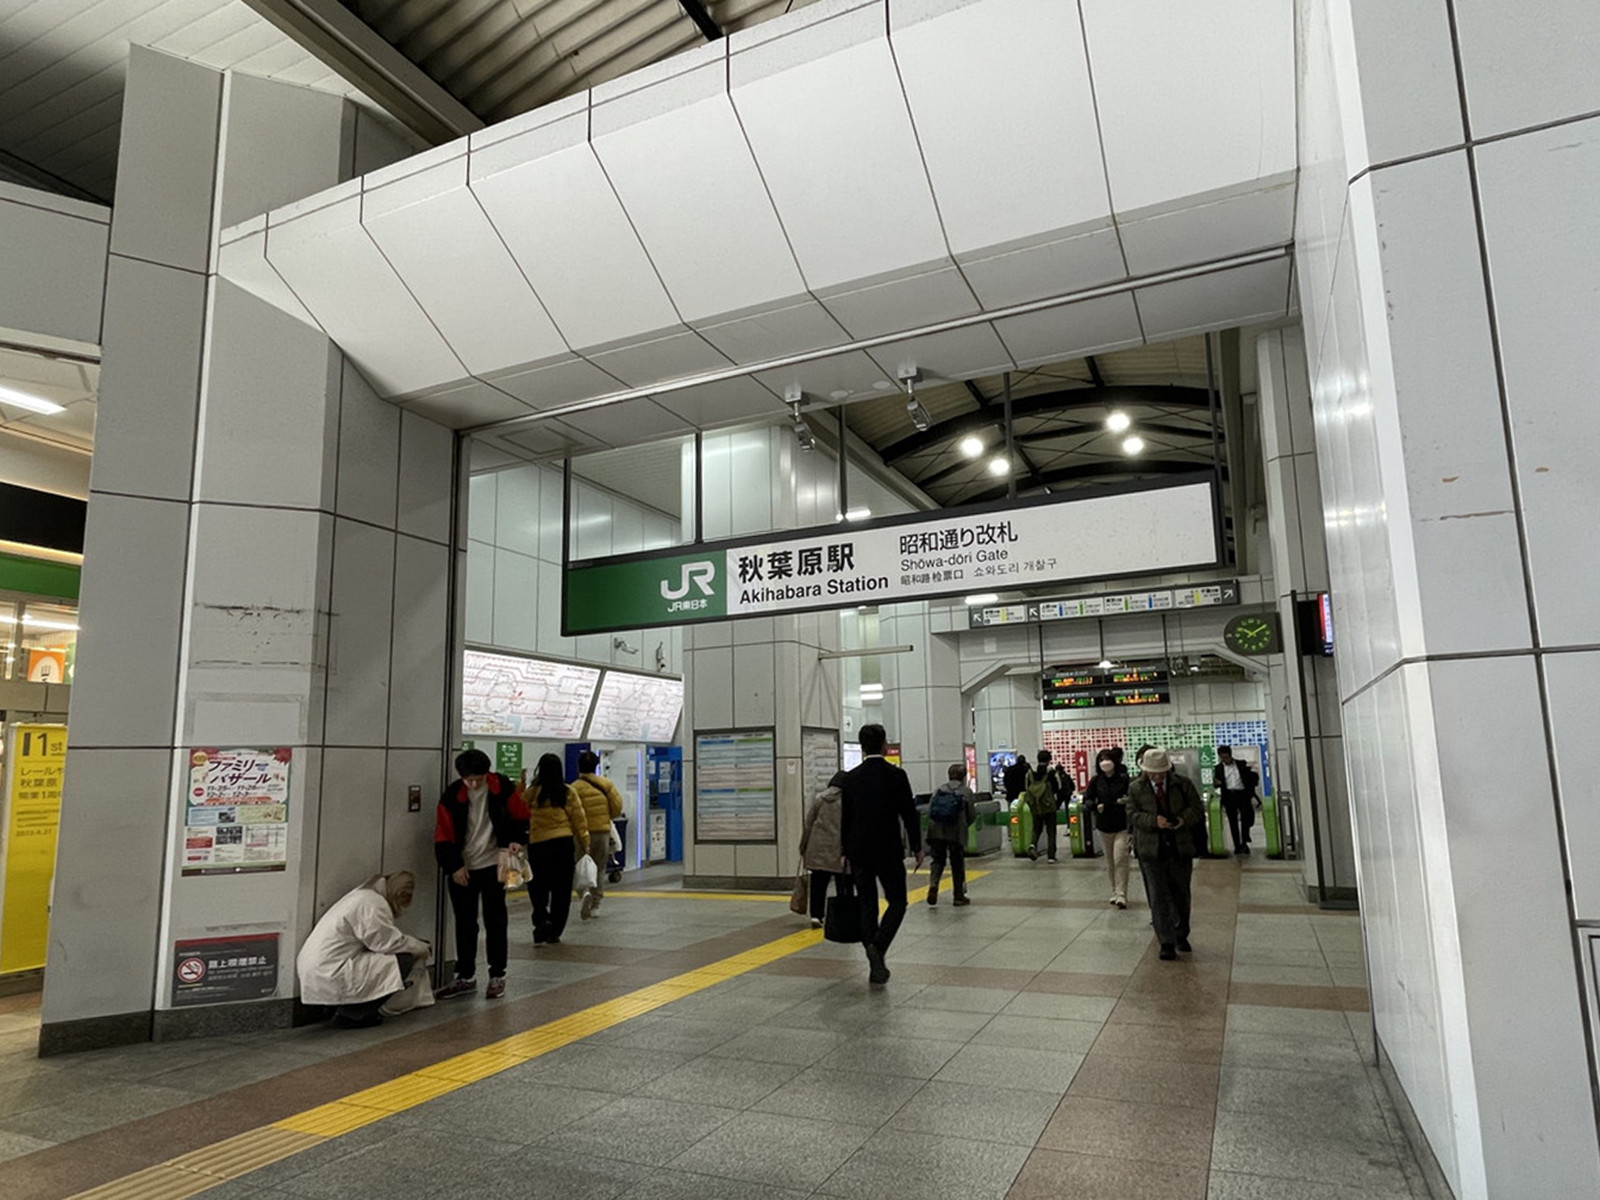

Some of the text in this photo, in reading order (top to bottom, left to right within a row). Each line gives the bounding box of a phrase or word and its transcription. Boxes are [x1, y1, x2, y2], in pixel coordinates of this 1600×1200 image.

[900, 521, 1018, 555] 昭和通り改札
[738, 543, 855, 584] 秋葉原駅
[901, 549, 1008, 571] Shōwa-dōri Gate
[974, 558, 1057, 578] 쇼와도리 개찰구
[660, 560, 716, 600] JR
[739, 575, 889, 604] Akihabara Station
[667, 598, 708, 613] JR東日本
[208, 759, 269, 773] ファミリー
[209, 773, 271, 786] バザール
